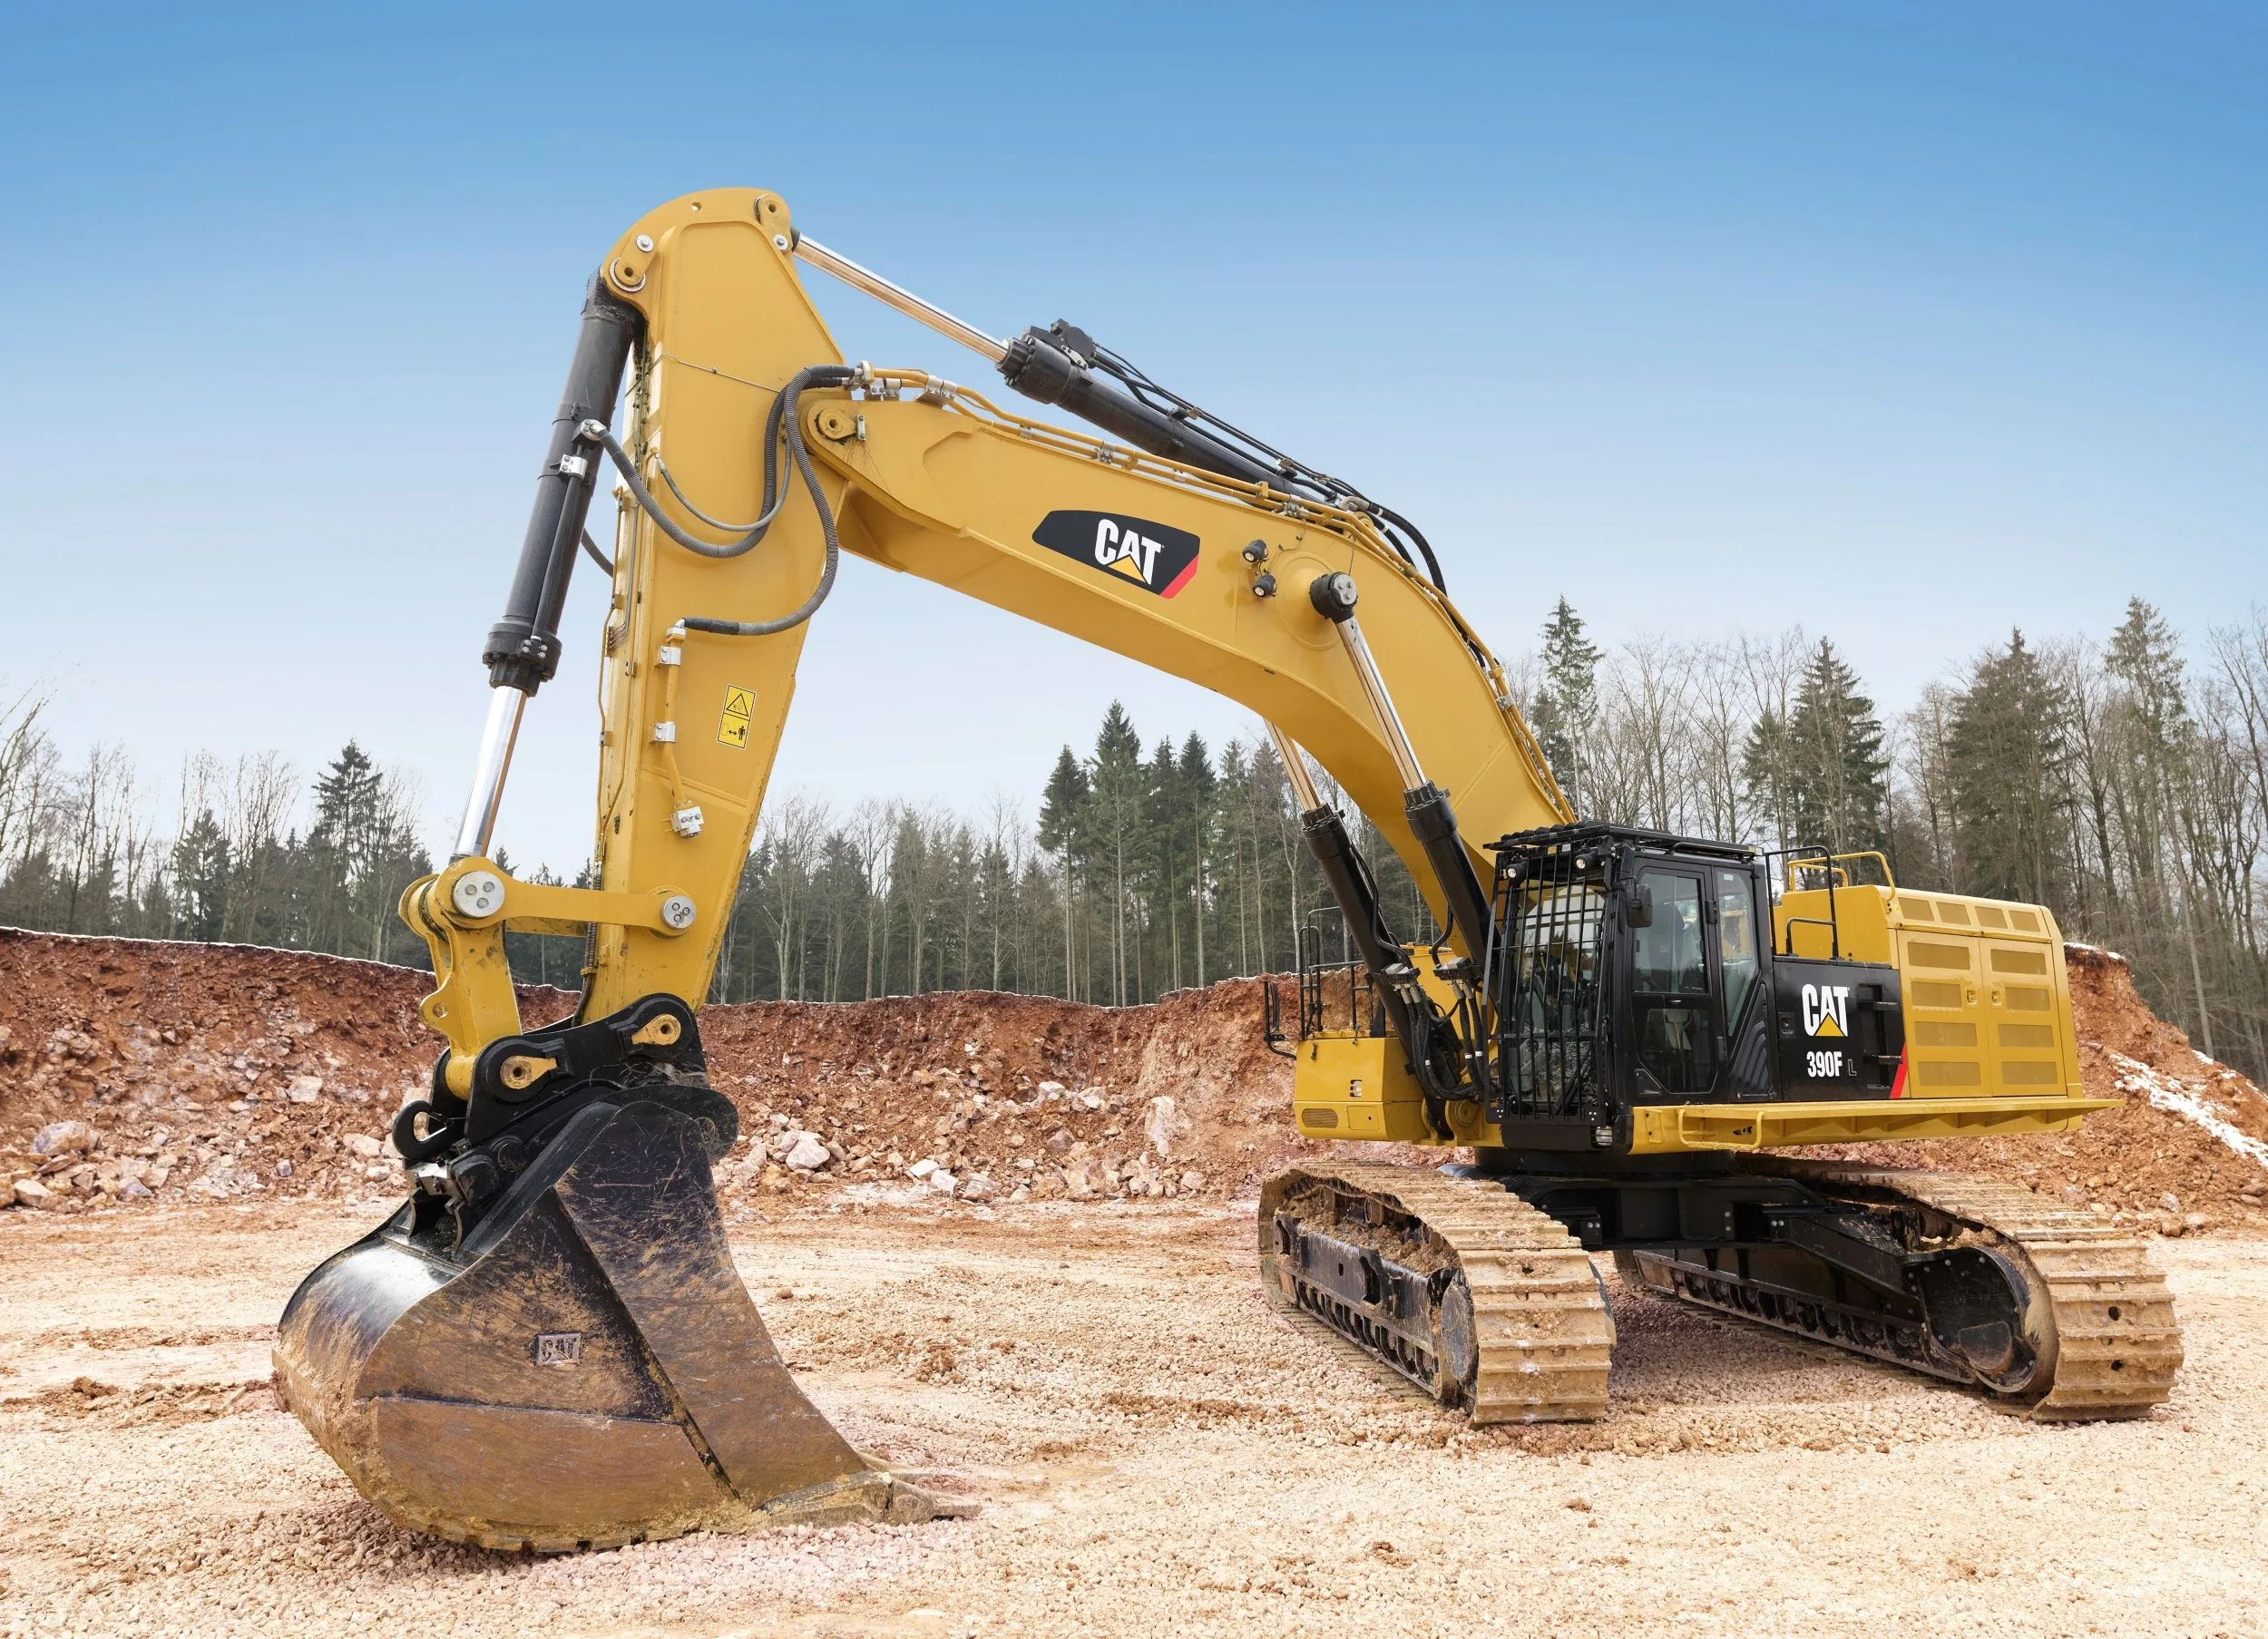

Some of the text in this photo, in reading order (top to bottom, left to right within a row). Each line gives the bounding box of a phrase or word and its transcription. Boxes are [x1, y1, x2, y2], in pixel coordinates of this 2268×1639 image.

[1094, 518, 1162, 585] CAT
[1802, 983, 1849, 1037] CAT
[1806, 1050, 1858, 1078] 390F L
